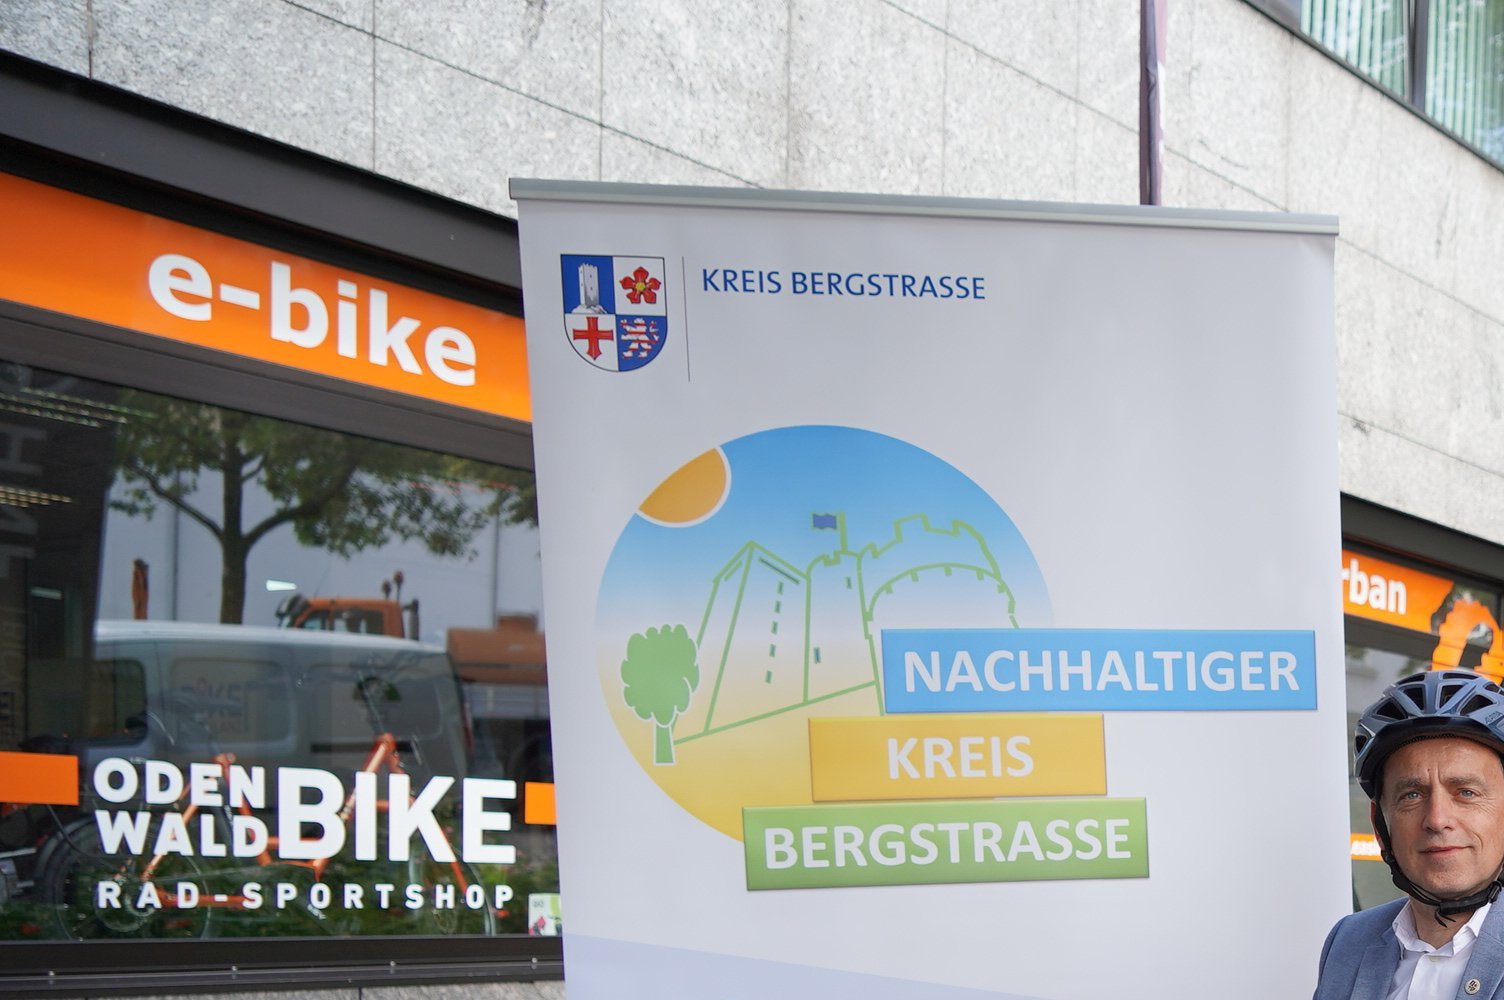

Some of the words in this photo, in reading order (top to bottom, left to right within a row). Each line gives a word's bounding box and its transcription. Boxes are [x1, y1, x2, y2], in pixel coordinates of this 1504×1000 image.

[702, 268, 782, 295] KREIS
[791, 271, 986, 300] BERGSTRASSE
[147, 252, 478, 387] e-bike
[904, 649, 1300, 693] NACHHALTIGER
[886, 735, 1035, 779] KREIS
[93, 756, 266, 810] ODEN
[94, 809, 270, 858] WALD
[277, 766, 518, 864] BIKE
[763, 818, 1132, 870] BERGSTRASSE
[97, 880, 515, 911] RAD-SPORTSHOP
